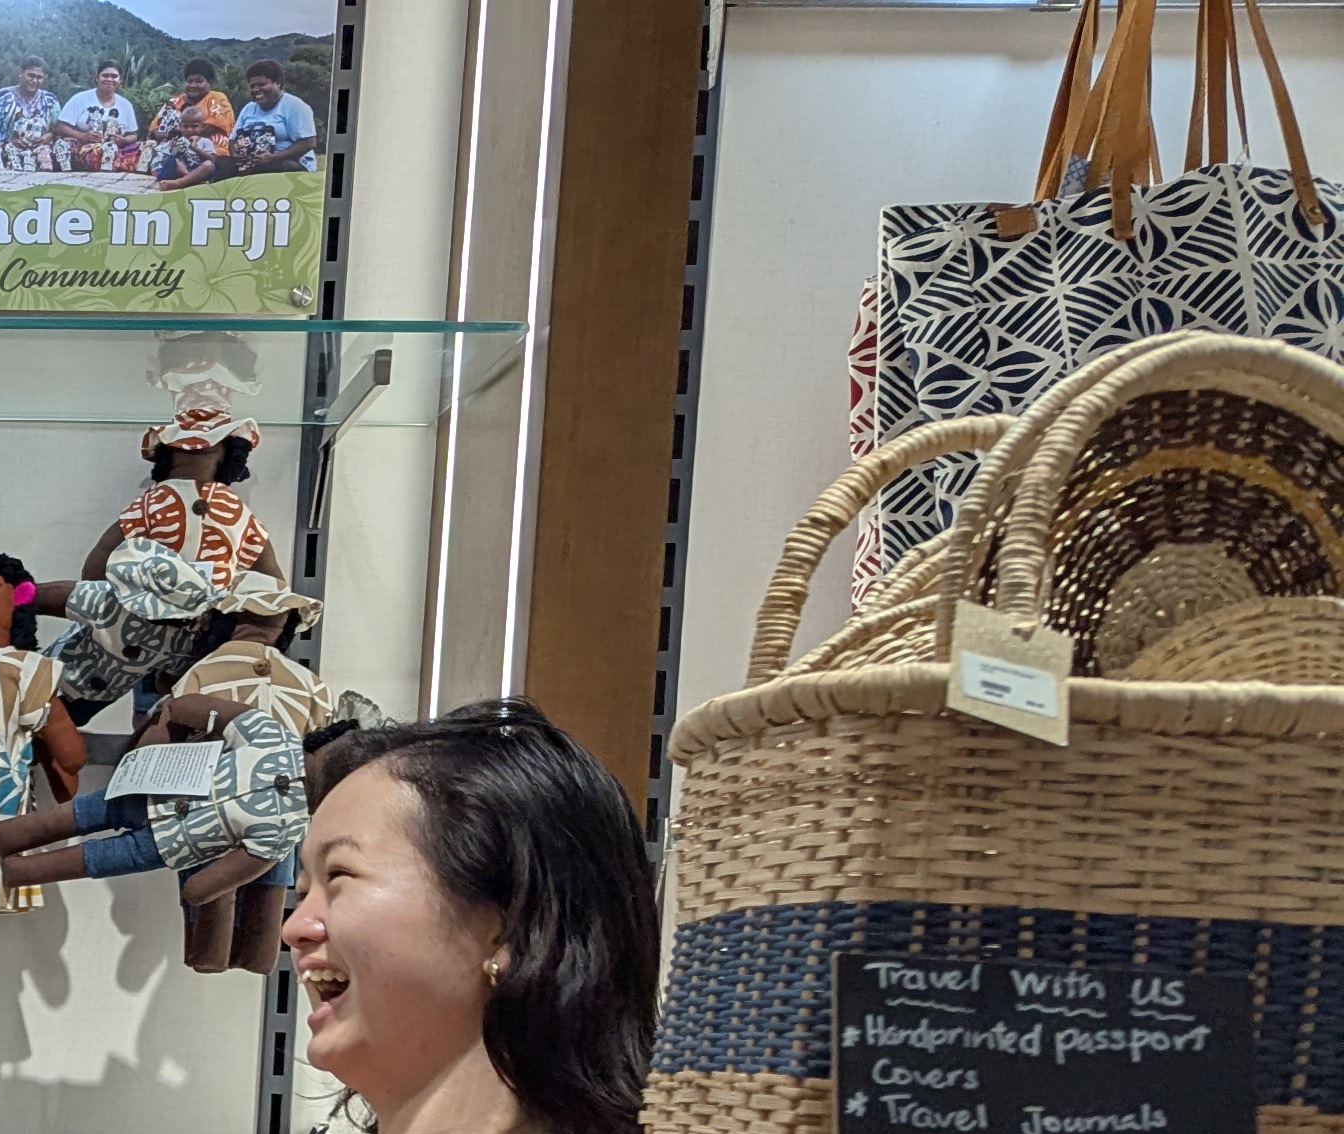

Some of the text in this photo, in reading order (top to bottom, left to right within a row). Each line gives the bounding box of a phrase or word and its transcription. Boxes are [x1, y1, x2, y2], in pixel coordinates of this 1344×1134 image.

[111, 197, 170, 246] in
[189, 197, 293, 262] Fiji
[0, 258, 187, 298] Community
[863, 961, 983, 993] Travel
[864, 1014, 1044, 1058] Handprinted
[871, 1057, 980, 1091] Covers
[879, 1093, 990, 1133] Travel
